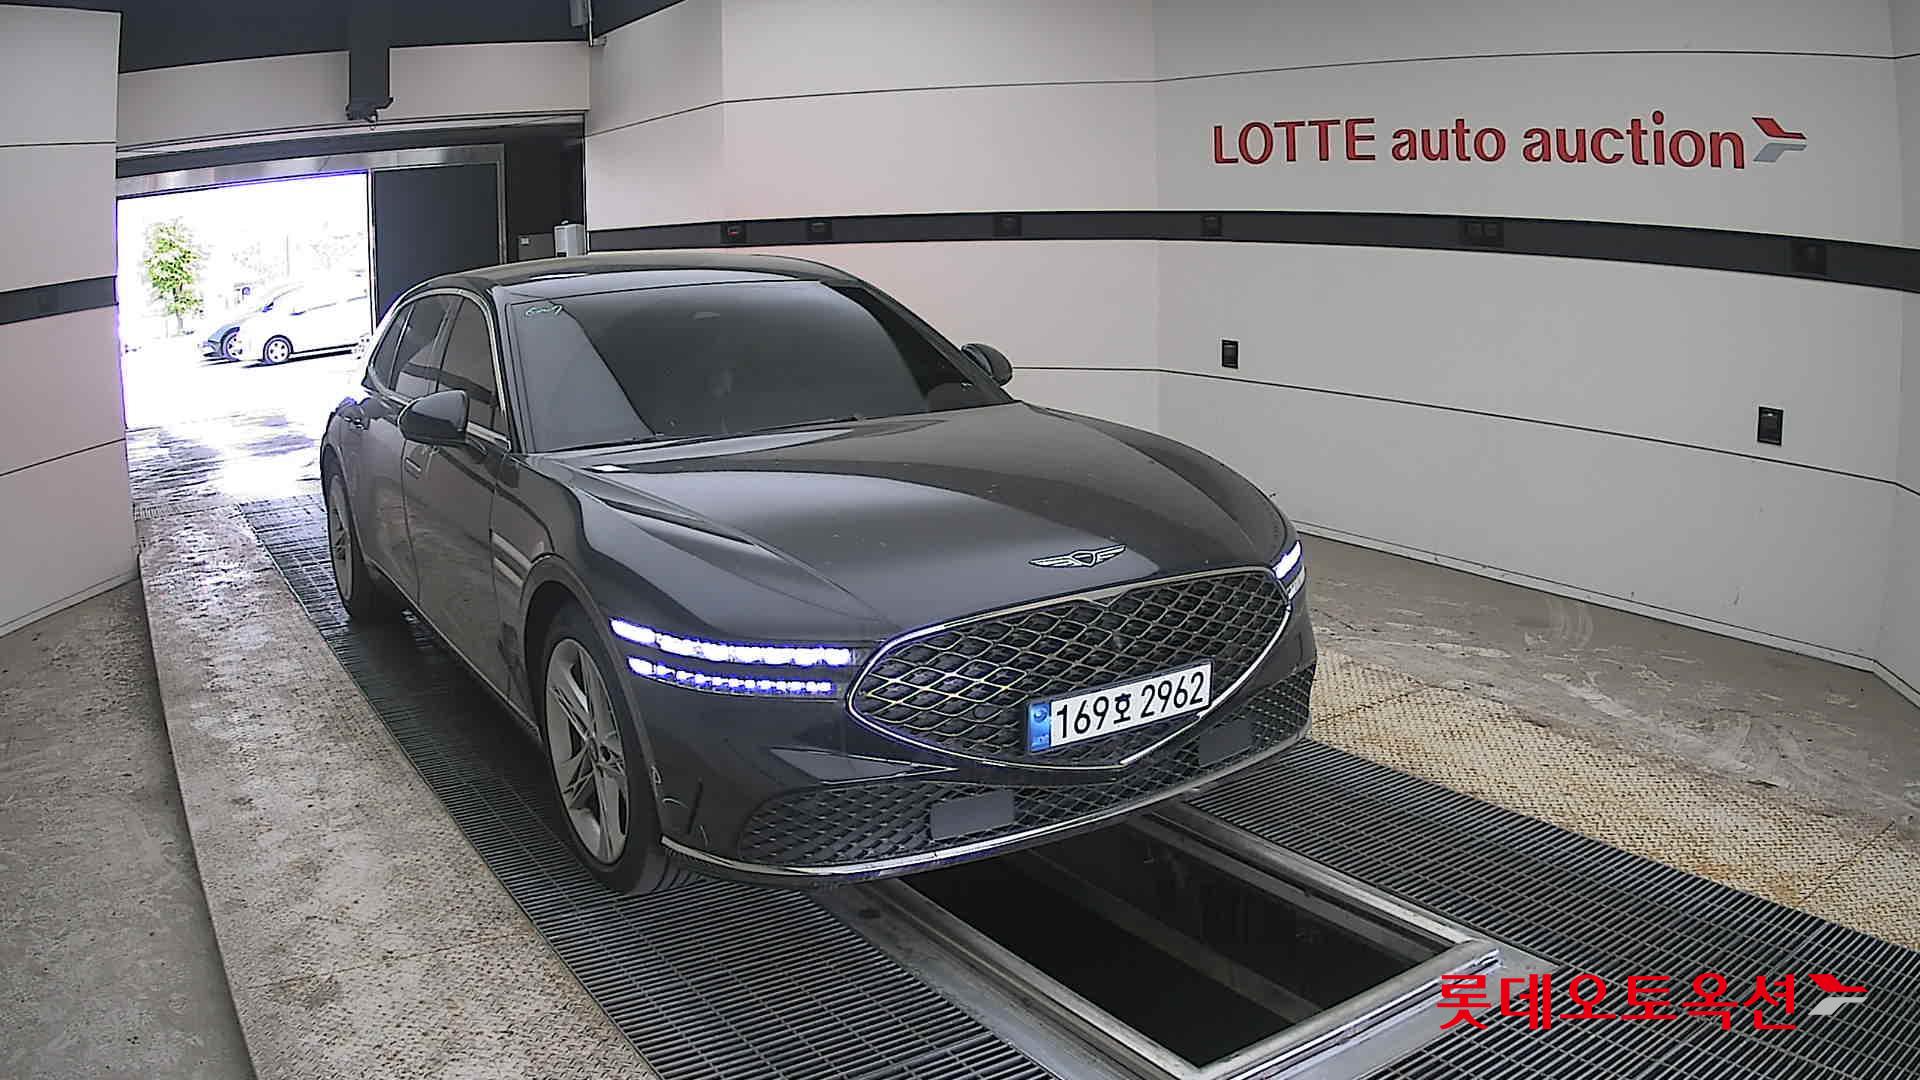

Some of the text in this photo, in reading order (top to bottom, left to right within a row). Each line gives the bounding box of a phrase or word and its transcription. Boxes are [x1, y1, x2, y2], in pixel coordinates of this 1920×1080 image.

[1212, 110, 1745, 170] LOTTE auto auction
[1056, 671, 1205, 739] 169호 2962
